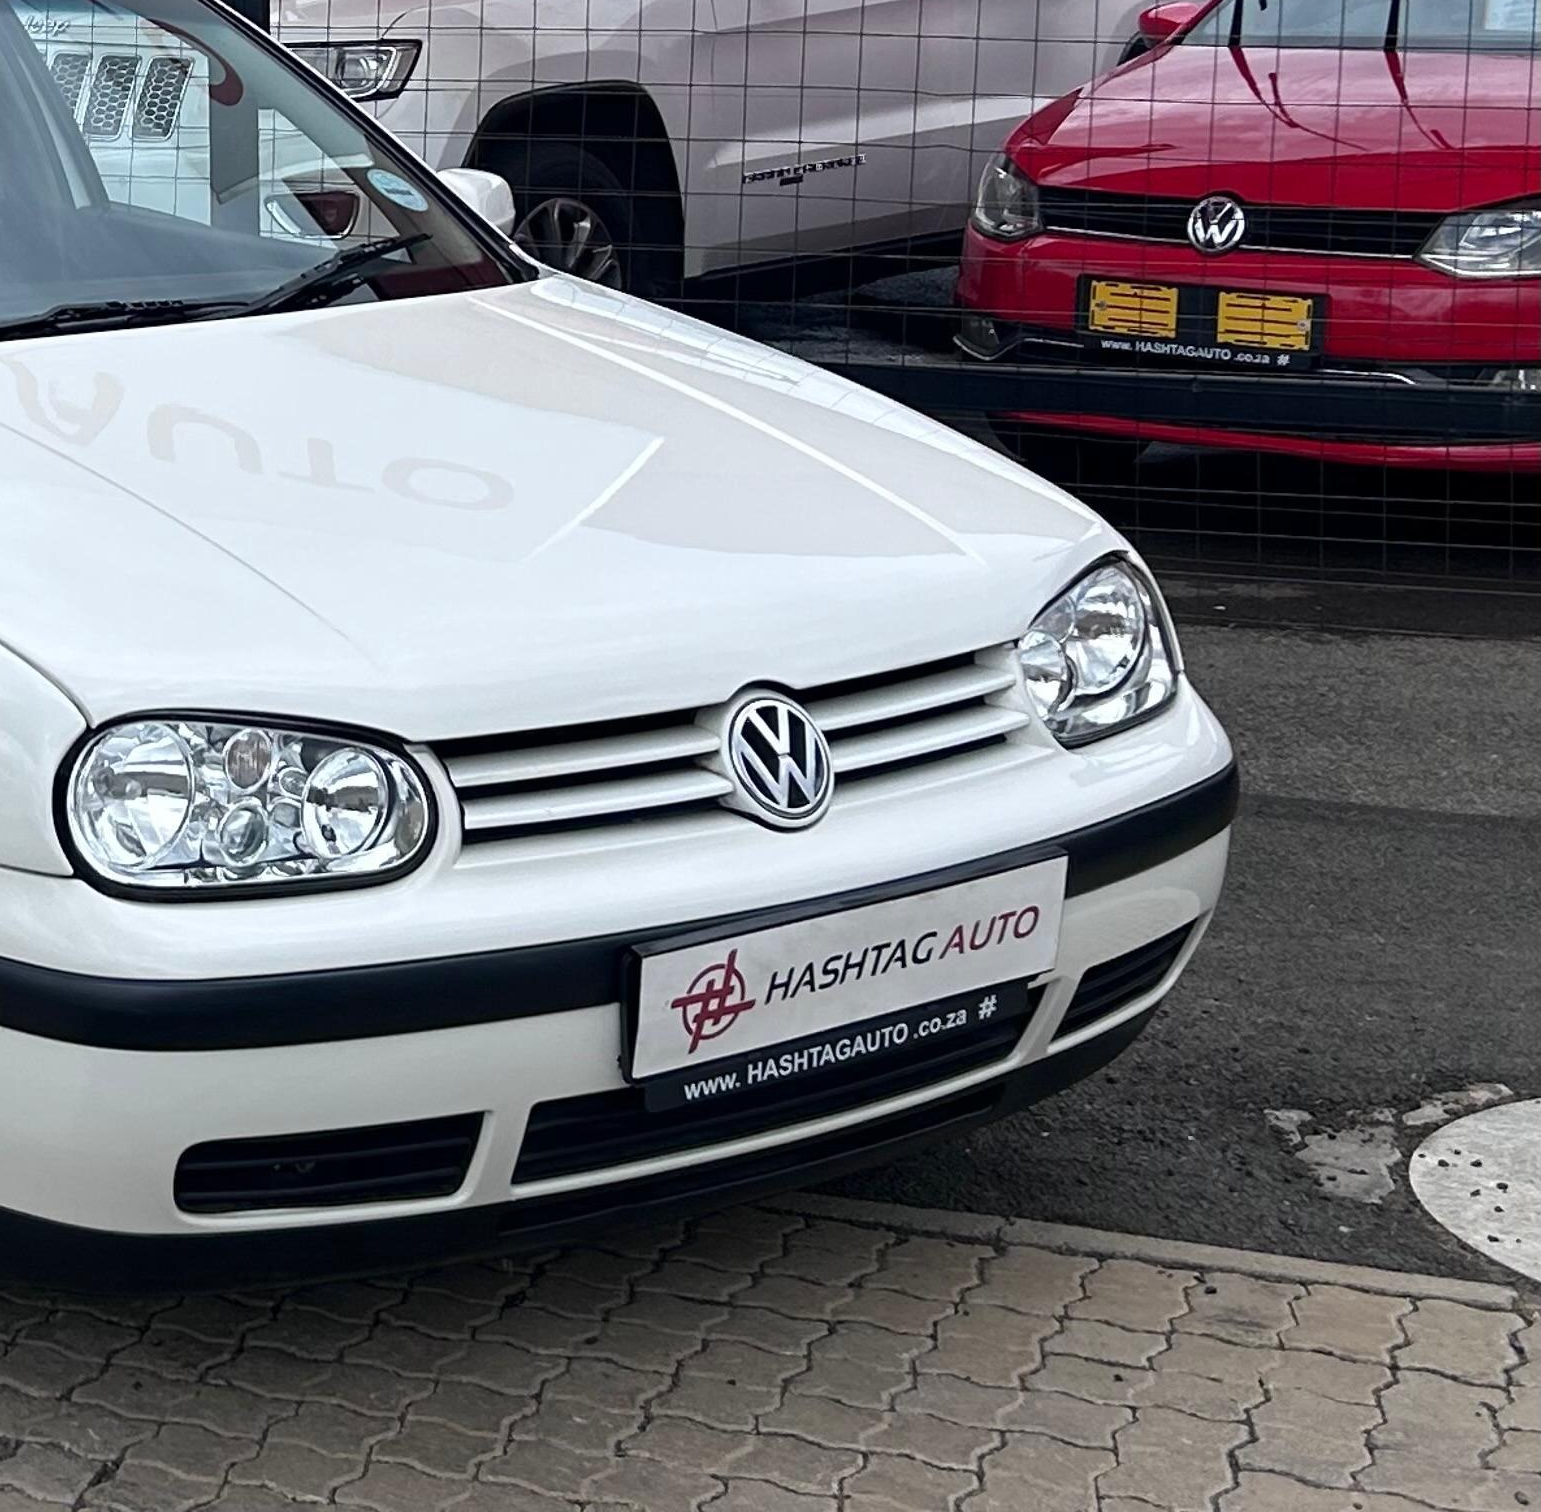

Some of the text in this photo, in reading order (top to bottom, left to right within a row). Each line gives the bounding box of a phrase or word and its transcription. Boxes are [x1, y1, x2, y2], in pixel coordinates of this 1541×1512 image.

[1135, 341, 1232, 361] HASHTAGAUTO
[764, 905, 1040, 1005] HASHTAG AUTO
[684, 1072, 740, 1101] www.
[747, 1023, 909, 1085] HASHTAGAUTO
[912, 1008, 967, 1039] .co.za
